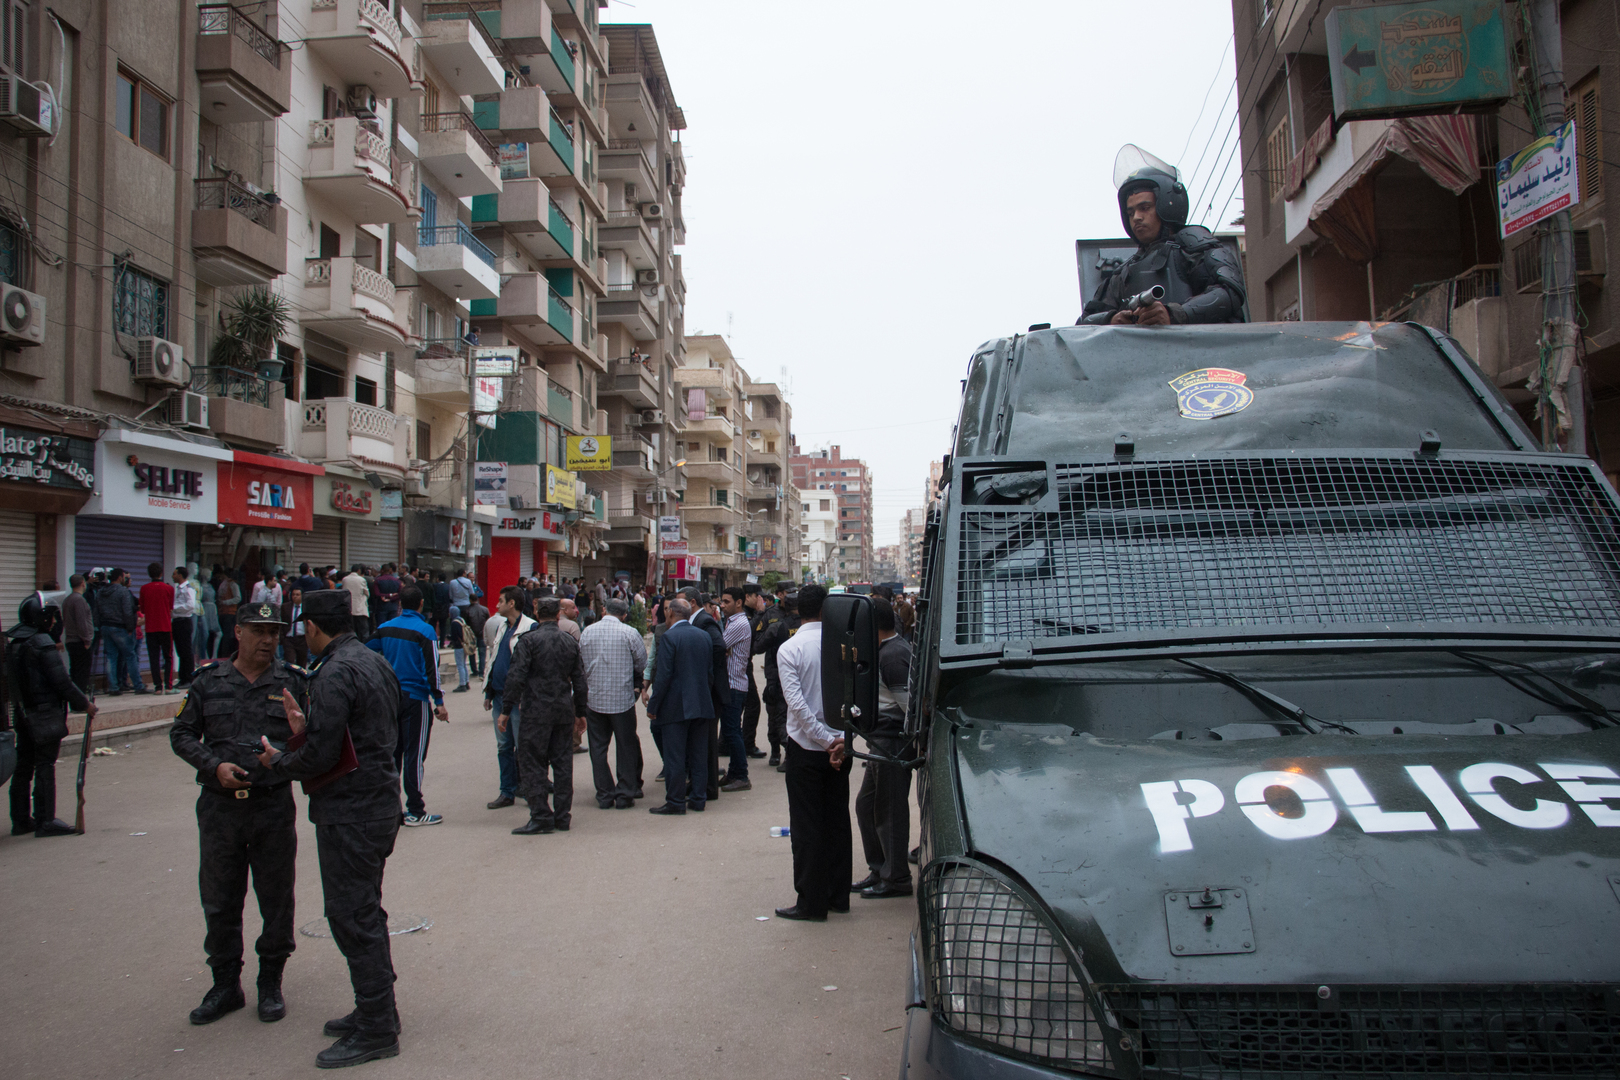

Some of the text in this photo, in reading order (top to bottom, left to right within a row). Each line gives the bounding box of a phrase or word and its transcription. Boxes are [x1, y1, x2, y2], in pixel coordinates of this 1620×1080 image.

[1381, 15, 1462, 46] مسجد
[1388, 49, 1464, 91] التقوى
[1501, 155, 1571, 209] وليد سليمان
[1182, 378, 1207, 387] CENTRAL
[1214, 406, 1238, 416] SECURITY
[0, 428, 36, 456] late
[0, 457, 33, 480] الشيكو
[134, 463, 204, 497] SELFIE
[479, 466, 503, 474] ReShape
[148, 498, 191, 510] Mobile Service
[247, 481, 295, 510] SARA
[331, 481, 372, 514] تحفة
[274, 513, 292, 521] Fashion
[1140, 761, 1620, 853] POLICE
